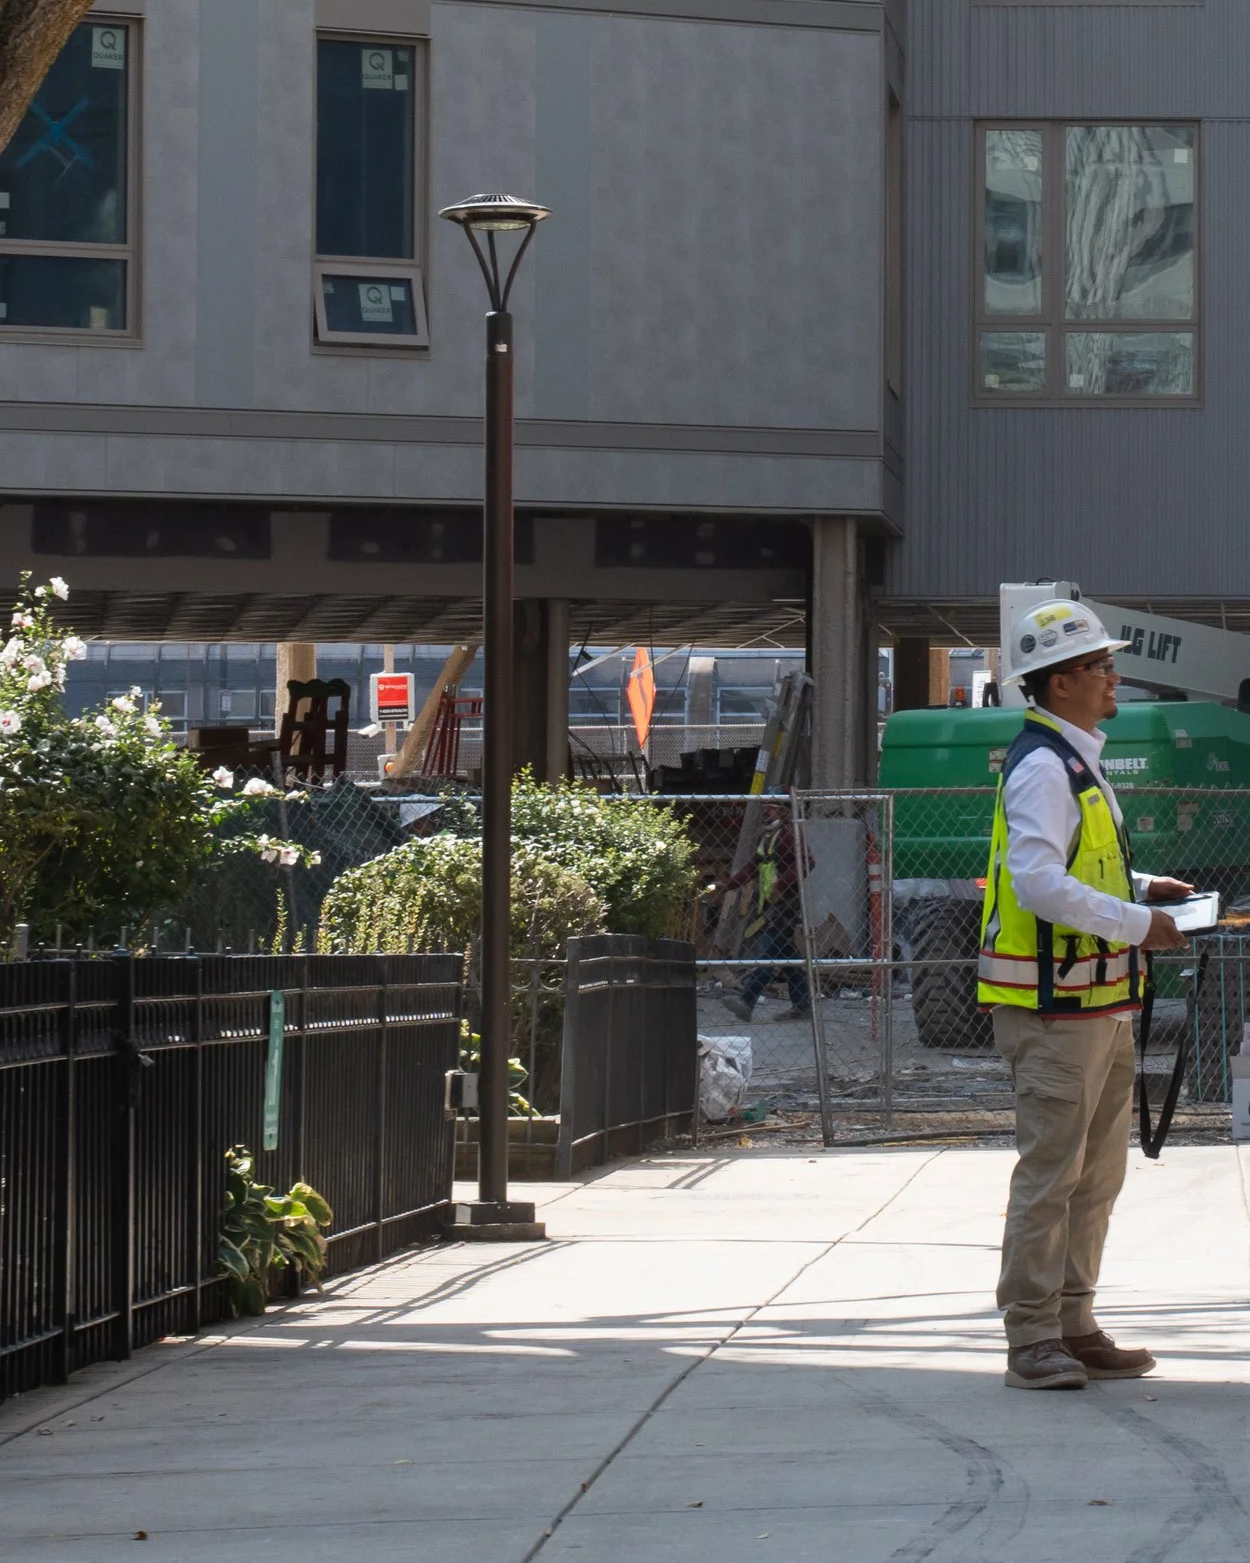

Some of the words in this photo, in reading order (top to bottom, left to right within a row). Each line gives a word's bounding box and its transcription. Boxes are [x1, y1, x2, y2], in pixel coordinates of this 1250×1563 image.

[100, 30, 117, 50] Q
[92, 52, 124, 61] QUAKER
[369, 52, 385, 72] Q
[363, 72, 393, 81] QUAKER
[366, 285, 383, 305] Q
[362, 306, 392, 315] QUAKER
[1147, 631, 1182, 664] LIFT
[1100, 757, 1148, 770] NBELT
